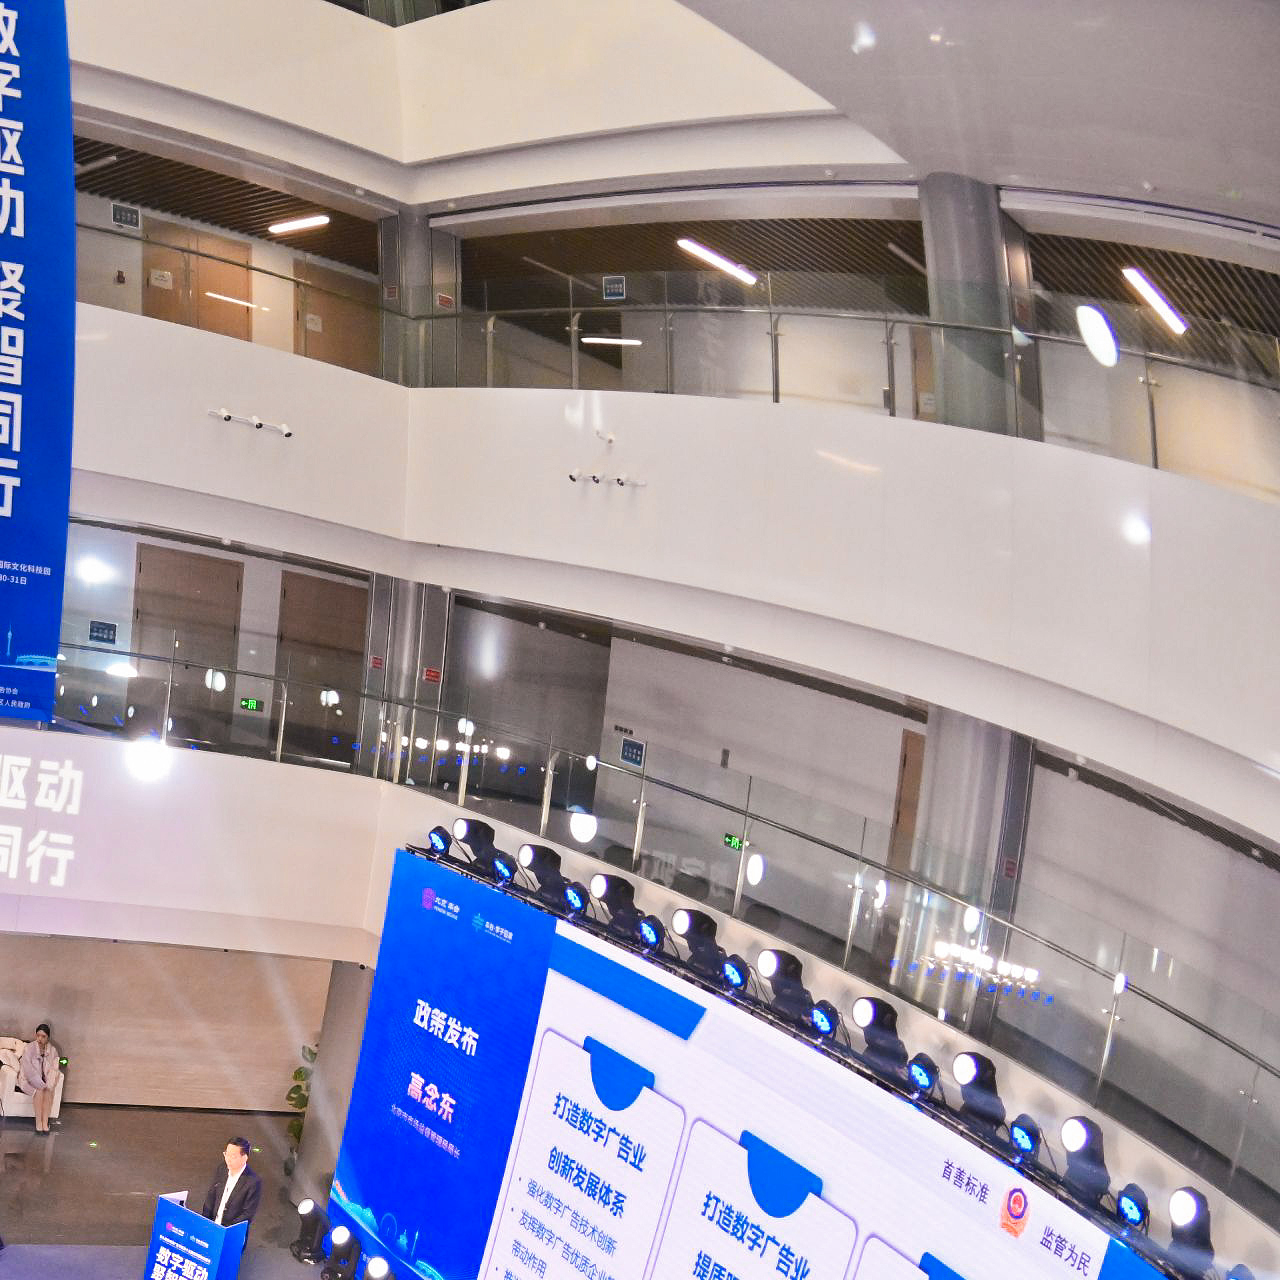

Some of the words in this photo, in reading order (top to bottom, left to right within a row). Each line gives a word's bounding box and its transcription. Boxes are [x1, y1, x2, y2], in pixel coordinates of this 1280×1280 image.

[412, 998, 480, 1057] 政策发布
[407, 1072, 457, 1124] 高念东
[552, 1091, 648, 1173] 打造数字广告业
[547, 1145, 628, 1219] 创新发展体系
[941, 1159, 991, 1206] 首善标准
[526, 1178, 618, 1258] 强化数字广告技术创新
[511, 1239, 548, 1280] 带动作用
[1039, 1225, 1092, 1277] 监管为民
